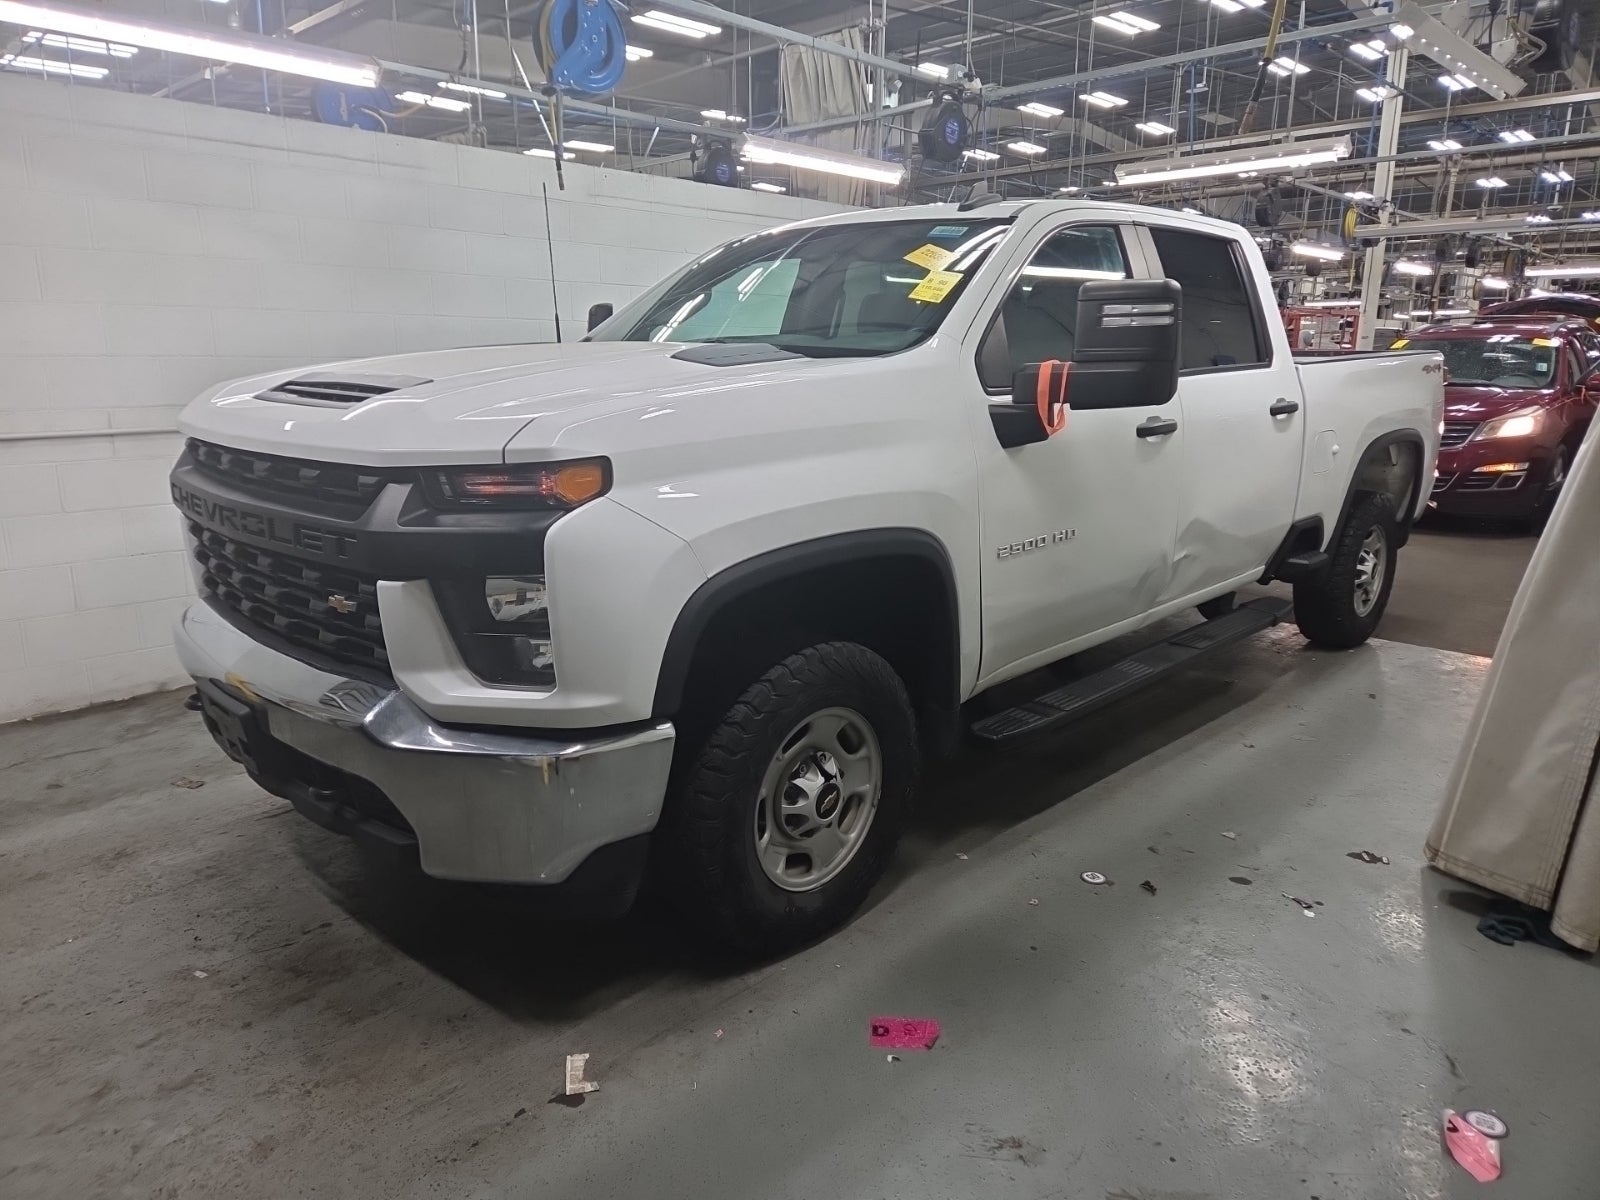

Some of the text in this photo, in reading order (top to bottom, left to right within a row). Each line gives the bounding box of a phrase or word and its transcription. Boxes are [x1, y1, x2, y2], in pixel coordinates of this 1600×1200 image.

[171, 482, 358, 559] CHEVROLET
[997, 528, 1077, 558] 2500 HD
